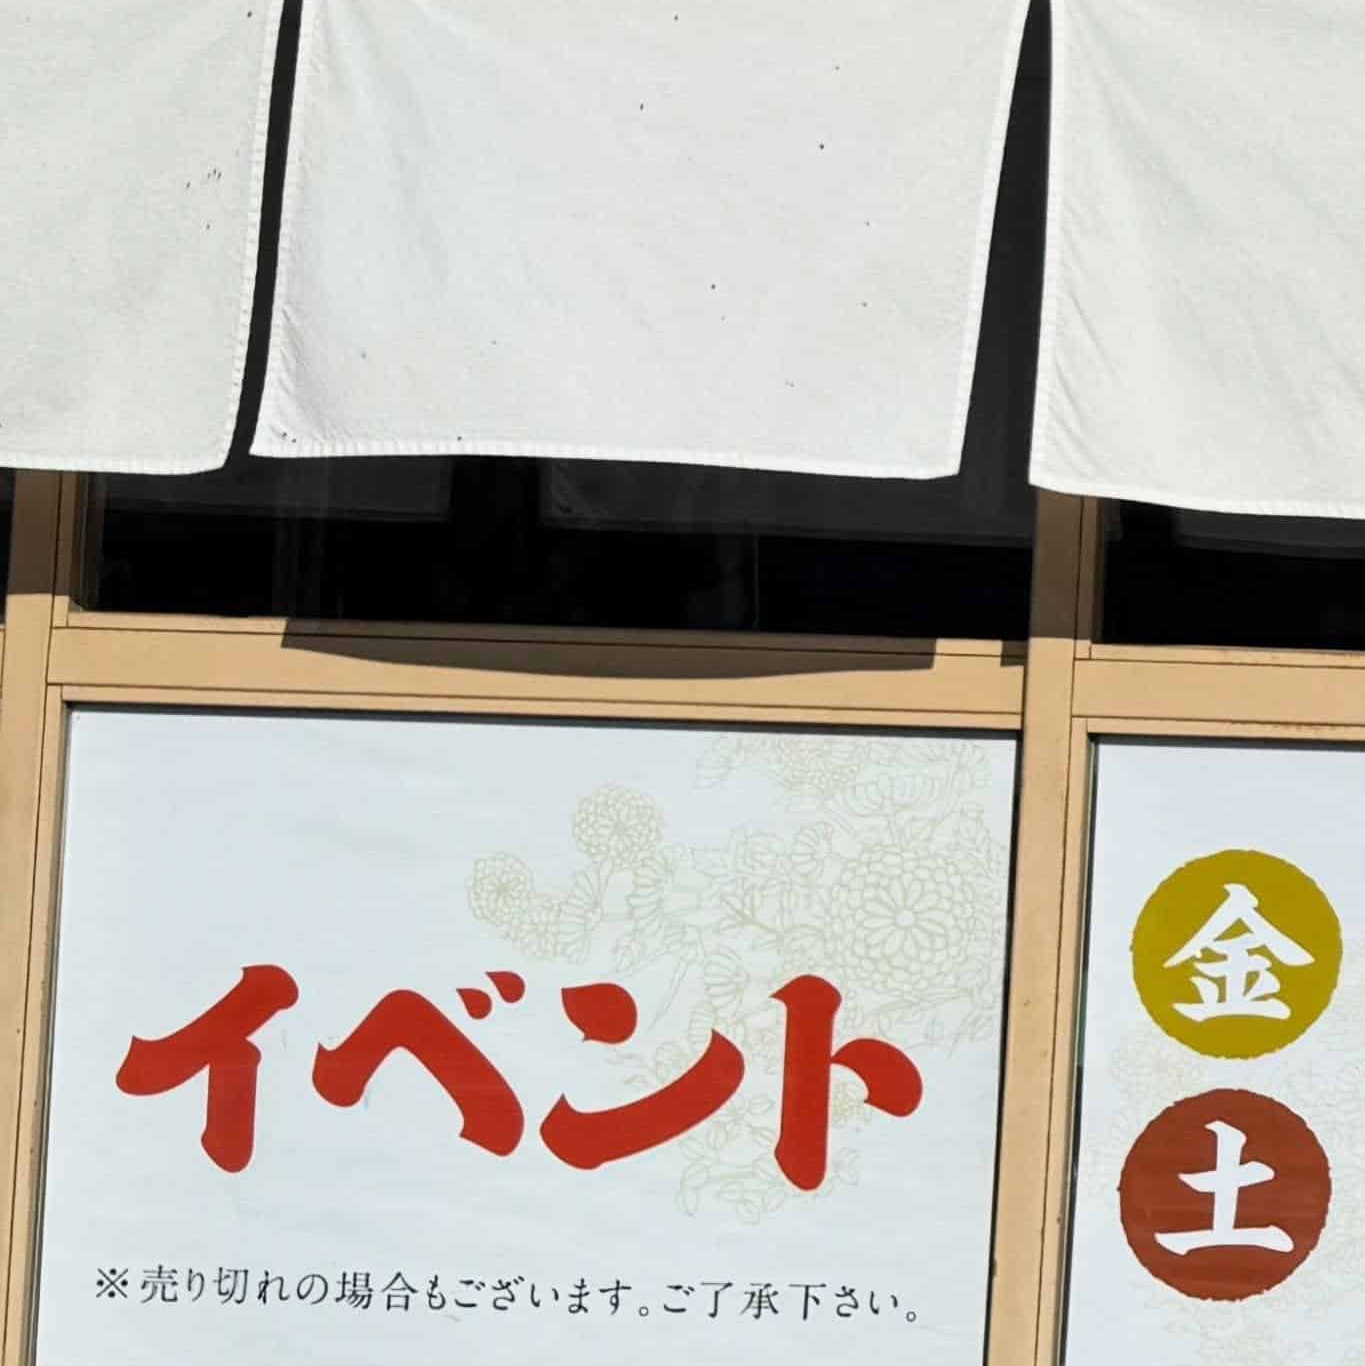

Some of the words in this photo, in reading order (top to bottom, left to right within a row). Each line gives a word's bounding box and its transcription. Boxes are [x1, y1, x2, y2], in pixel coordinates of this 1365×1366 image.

[1162, 882, 1314, 1022] 金
[115, 964, 923, 1192] イベント
[1154, 1119, 1295, 1256] 土
